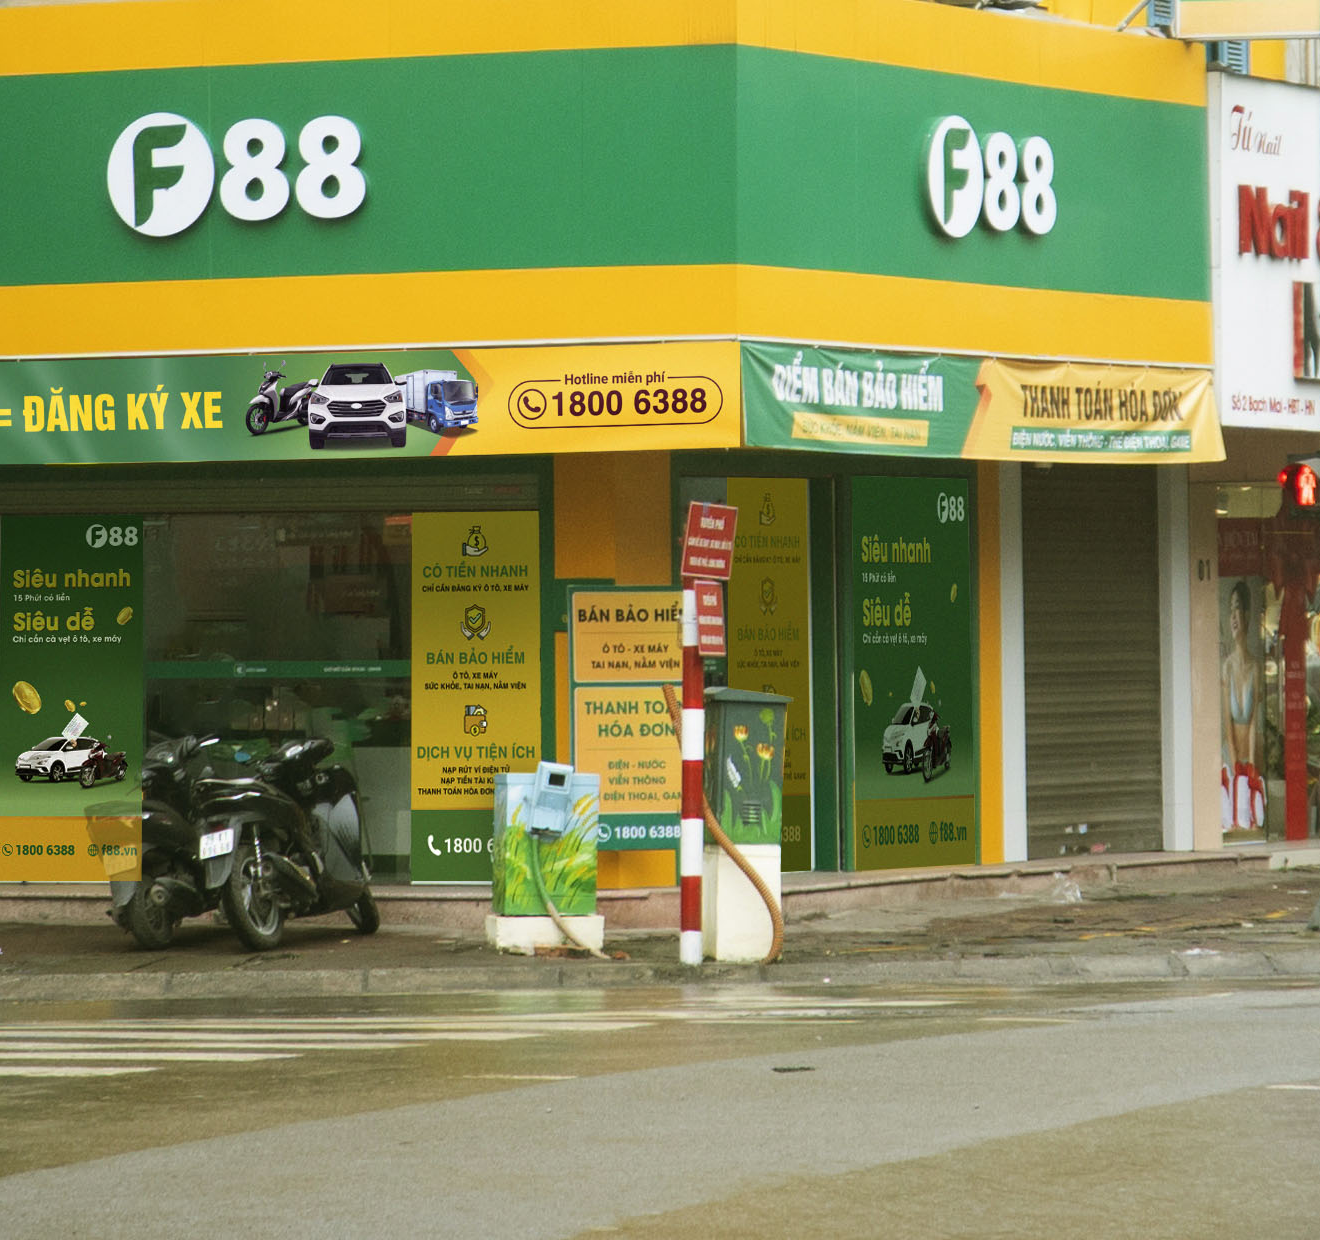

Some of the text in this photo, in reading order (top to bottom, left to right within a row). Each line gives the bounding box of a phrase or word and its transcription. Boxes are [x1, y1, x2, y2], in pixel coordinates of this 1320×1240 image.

[108, 112, 367, 237] F88
[927, 115, 1057, 238] F88
[1238, 184, 1309, 260] Nail
[564, 369, 665, 386] Hotline miễn phí
[822, 362, 858, 407] BÁN
[862, 360, 897, 409] BẢO
[900, 360, 943, 412] HIỂM
[23, 387, 116, 433] ĐĂNG
[127, 384, 169, 431] KÝ
[180, 391, 223, 430] XE
[552, 388, 708, 418] 1800 6388
[1020, 380, 1183, 422] THANH TOÁN HÓA ĐƠN
[937, 492, 965, 523] F88
[86, 524, 138, 548] F88
[861, 535, 931, 563] Siêu nhanh
[13, 569, 131, 588] Siêu nhanh
[423, 561, 528, 578] CÓ TIỀN NHANH
[514, 583, 528, 591] MÁY
[13, 607, 95, 631] Siêu dễ
[578, 604, 609, 622] BÁN
[616, 603, 649, 622] BẢO
[863, 592, 911, 627] Siêu dễ
[13, 635, 27, 643] Chỉ
[28, 634, 44, 642] cần
[46, 635, 56, 643] cà
[58, 635, 71, 644] vẹt
[79, 635, 91, 643] tô,
[104, 635, 122, 644] máy
[426, 644, 525, 664] BÁN BẢO HIỂM
[591, 656, 680, 672] TAI NẠN, NẰM VIỆN
[453, 671, 458, 679] Ô
[483, 671, 498, 679] MÁY
[424, 682, 439, 690] SỨC
[475, 683, 492, 691] NẠN,
[510, 682, 526, 690] VIỆN
[598, 720, 675, 738] HÓA ĐƠN
[417, 742, 535, 761] DỊCH VỤ TIỆN ÍCH
[442, 767, 456, 775] NẠP
[459, 765, 472, 773] RÚT
[475, 765, 481, 773] VÍ
[482, 765, 499, 774] ĐIỆN
[441, 777, 455, 785] NẠP
[443, 787, 462, 795] TOÁN
[614, 825, 681, 839] 1800 6388
[873, 821, 967, 846] 1800 6388 f88.vn
[15, 843, 137, 857] 1800 6388 f88.vn
[445, 838, 482, 853] 1800
